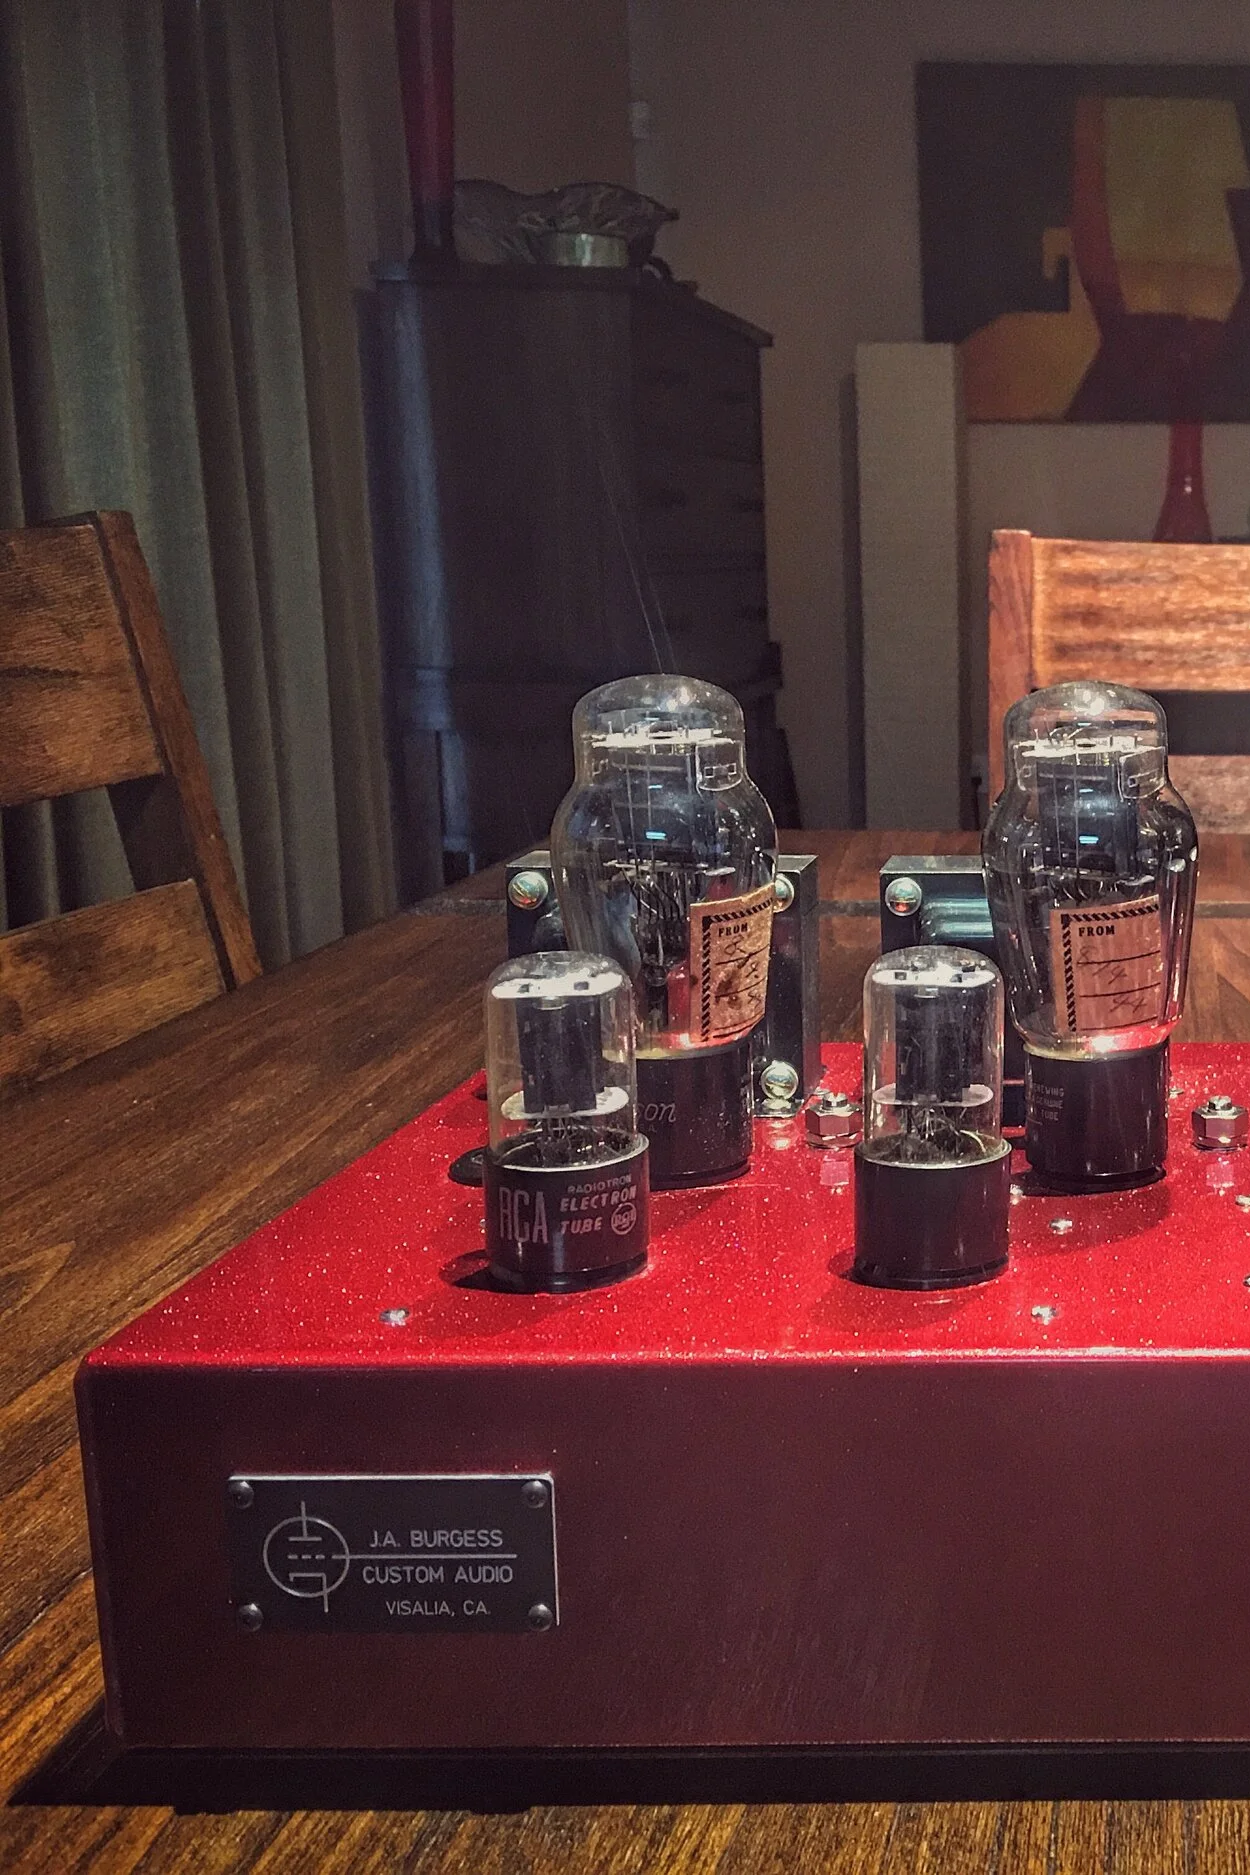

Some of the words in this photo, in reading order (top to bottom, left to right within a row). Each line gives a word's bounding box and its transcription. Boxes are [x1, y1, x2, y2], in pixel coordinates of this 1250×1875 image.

[1078, 925, 1115, 937] FROM
[567, 1173, 632, 1194] RADIOTRON
[560, 1185, 637, 1213] ELECTRON
[499, 1187, 549, 1244] RCA
[560, 1217, 603, 1234] TUBE
[369, 1530, 401, 1548] J.A.
[411, 1529, 503, 1547] BURGESS
[362, 1566, 445, 1584] CUSTOM
[454, 1565, 513, 1584] AUDIO
[385, 1600, 455, 1617] VISALIA,
[464, 1600, 491, 1616] CA.
